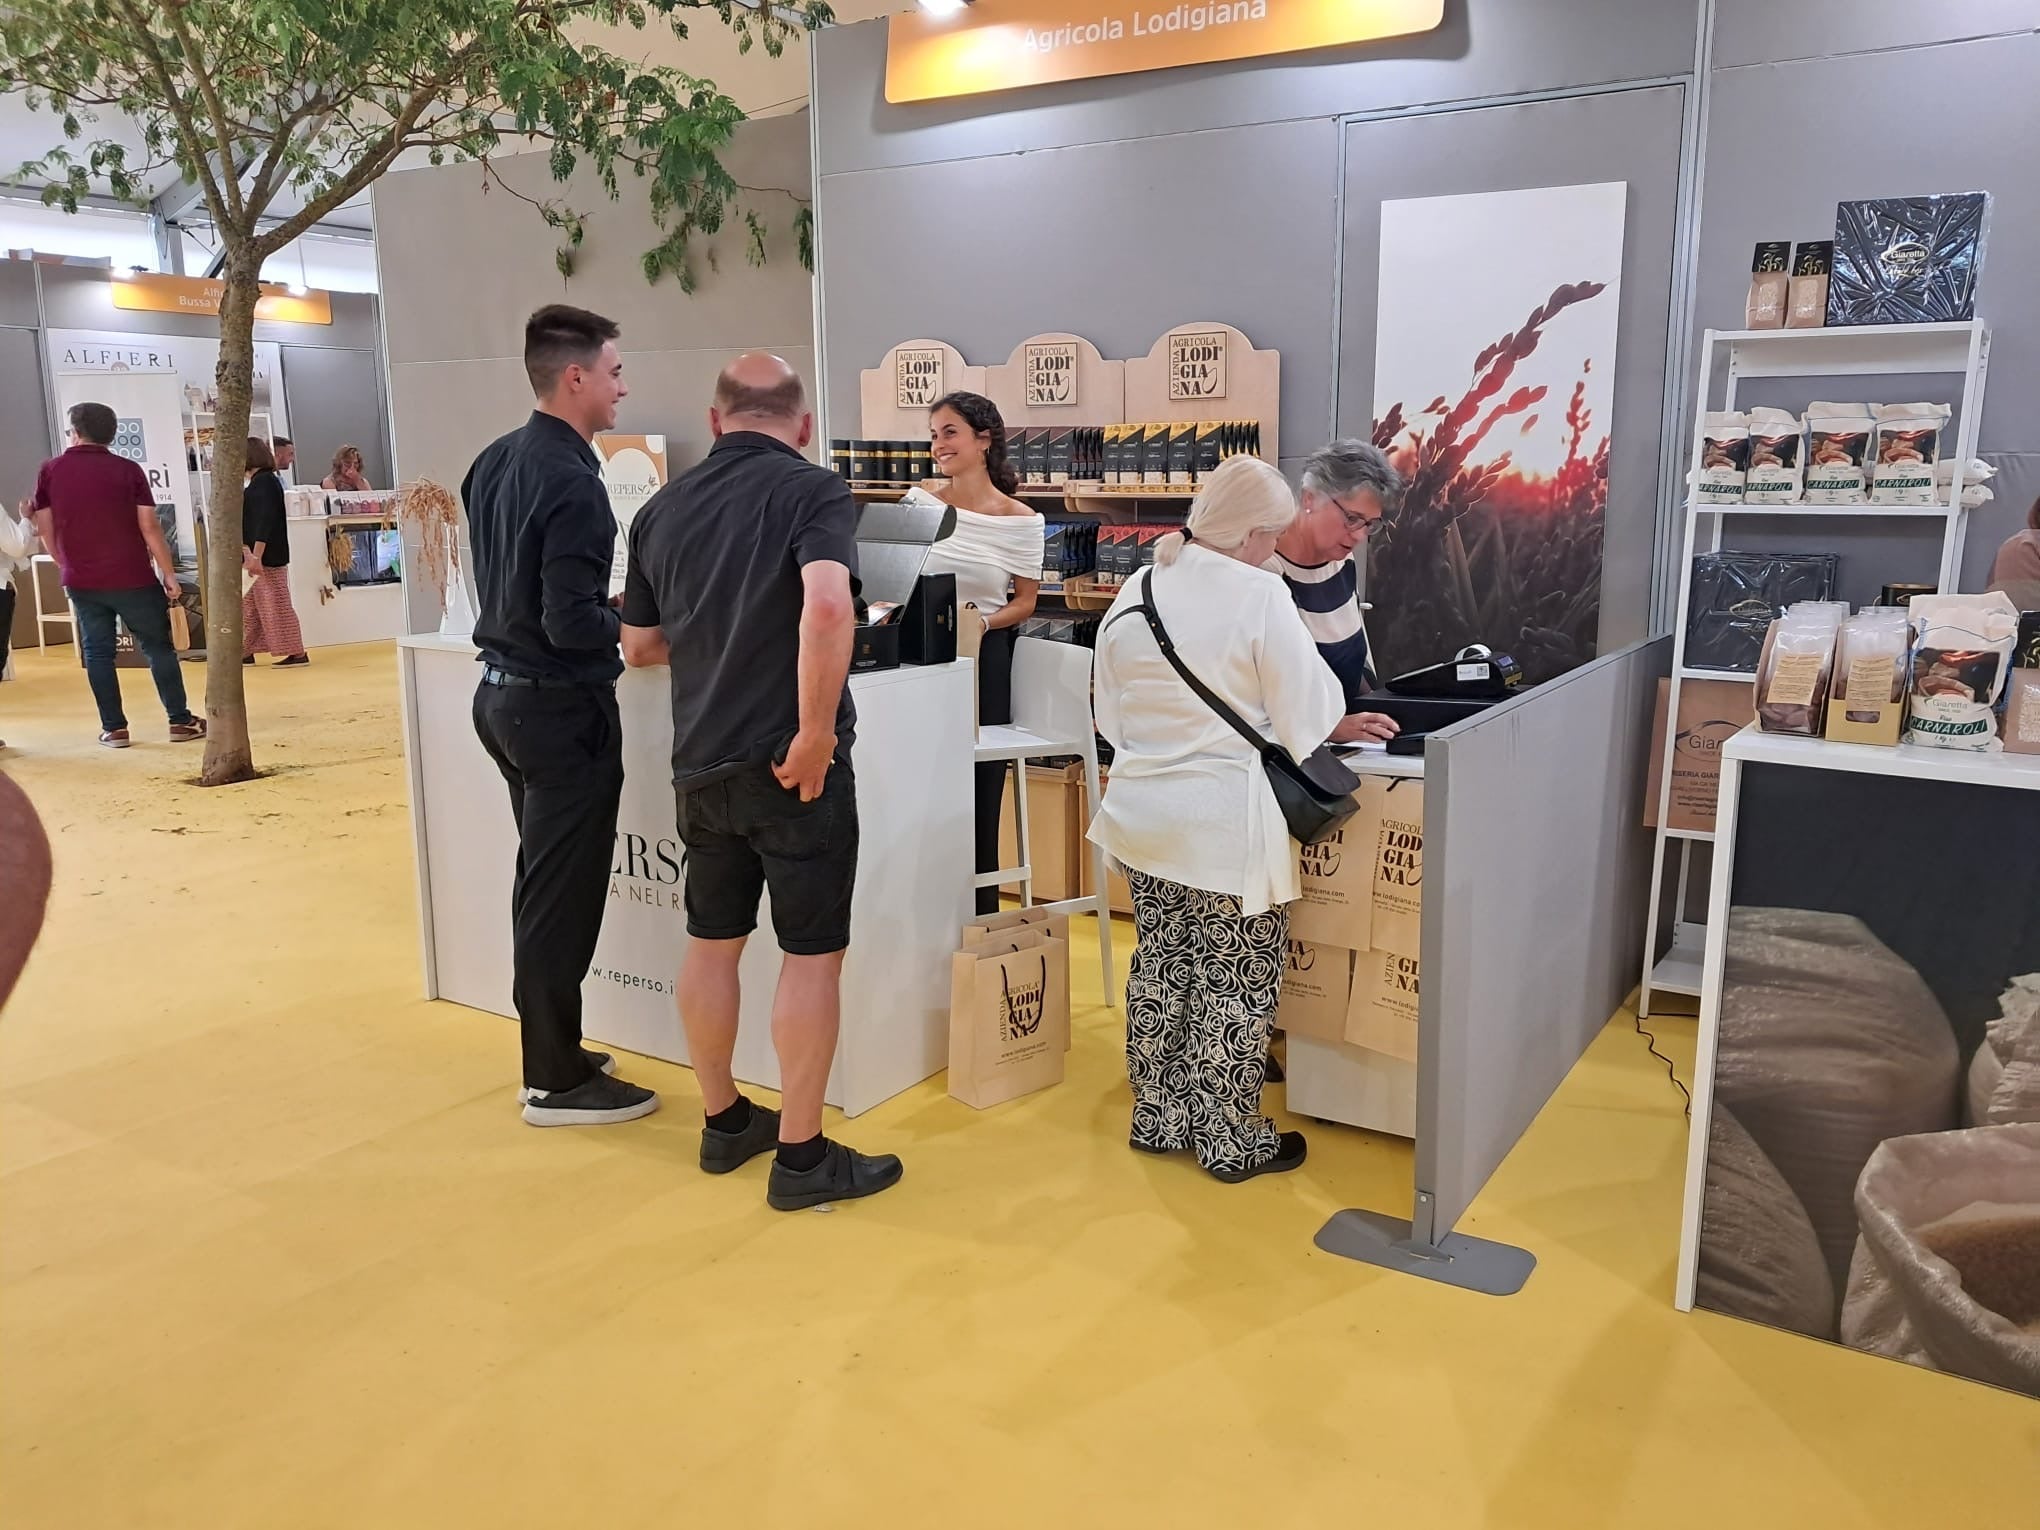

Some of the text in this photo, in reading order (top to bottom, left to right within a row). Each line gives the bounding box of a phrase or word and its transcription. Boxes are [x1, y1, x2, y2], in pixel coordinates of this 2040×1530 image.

[1023, 0, 1267, 53] Agricola Lodigiana
[179, 295, 211, 308] Bussa
[1172, 337, 1217, 348] AGRICOLA
[64, 348, 174, 368] ALFIERI
[899, 352, 936, 362] AGRICOLA
[1029, 347, 1069, 357] AGRICOLA
[1036, 372, 1061, 386] GIA
[1172, 350, 1180, 395] AZIENDA
[1180, 363, 1208, 379] GIA
[906, 376, 929, 390] GIA
[1028, 358, 1036, 402] AZIENDA
[1180, 380, 1202, 396] NA
[906, 391, 924, 405] NA
[1036, 388, 1055, 402] NA
[1747, 482, 1793, 491] ARNAROLI
[1875, 478, 1930, 488] CARNAROLI
[1701, 771, 1719, 779] GIAR
[1382, 818, 1424, 836] AGRICOL
[1387, 830, 1423, 852] LOD
[1301, 844, 1330, 861] GIA
[1383, 848, 1415, 869] GIA
[1299, 859, 1322, 877] NA
[1380, 865, 1405, 886] NA
[629, 884, 663, 907] NEL
[1302, 885, 1345, 898] lodigiana.com
[1288, 939, 1305, 955] IA
[1384, 952, 1395, 987] AZIEN
[1398, 957, 1418, 975] GI
[592, 966, 673, 995] w.reperso.i
